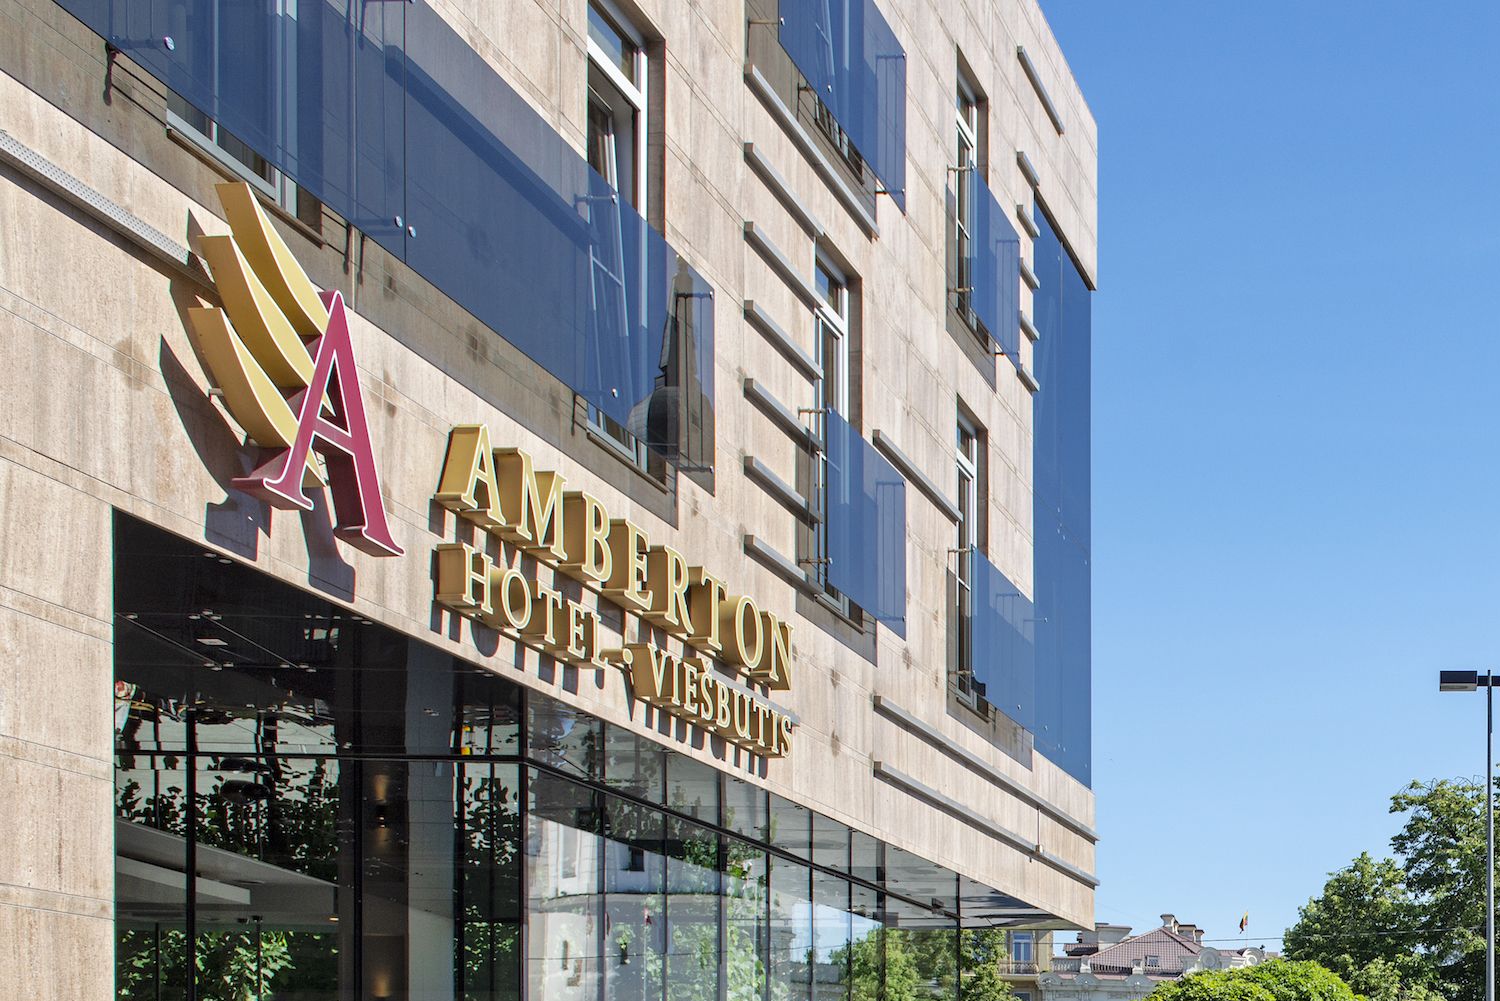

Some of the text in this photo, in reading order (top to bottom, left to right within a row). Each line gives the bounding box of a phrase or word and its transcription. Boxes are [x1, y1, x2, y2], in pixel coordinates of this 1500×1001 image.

[459, 423, 795, 691] AMBERTON
[461, 541, 793, 759] HOTEL VIEŠBUTIS
